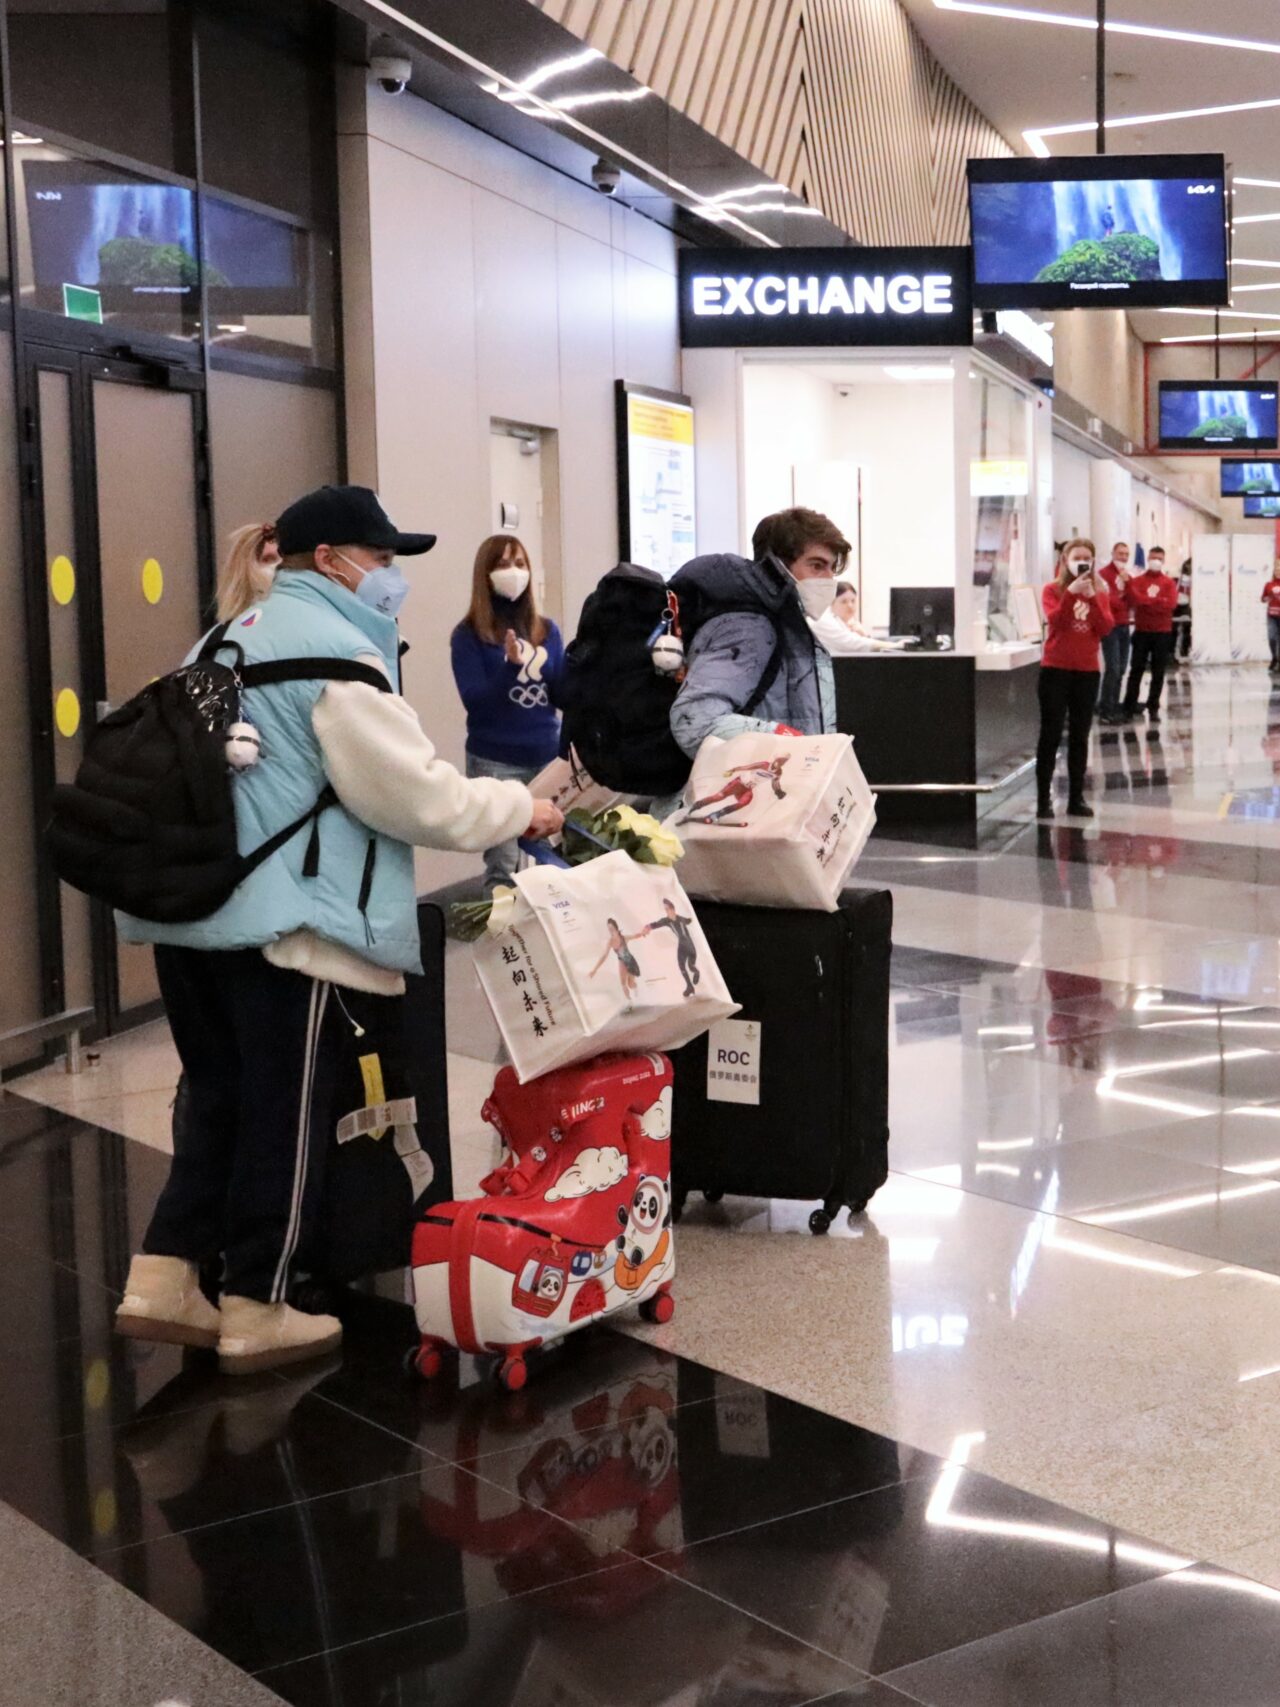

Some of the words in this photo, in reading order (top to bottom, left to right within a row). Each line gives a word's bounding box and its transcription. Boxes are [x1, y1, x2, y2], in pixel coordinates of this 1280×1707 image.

[691, 275, 954, 316] EXCHANGE
[552, 900, 571, 910] VISA
[717, 1049, 750, 1066] ROC
